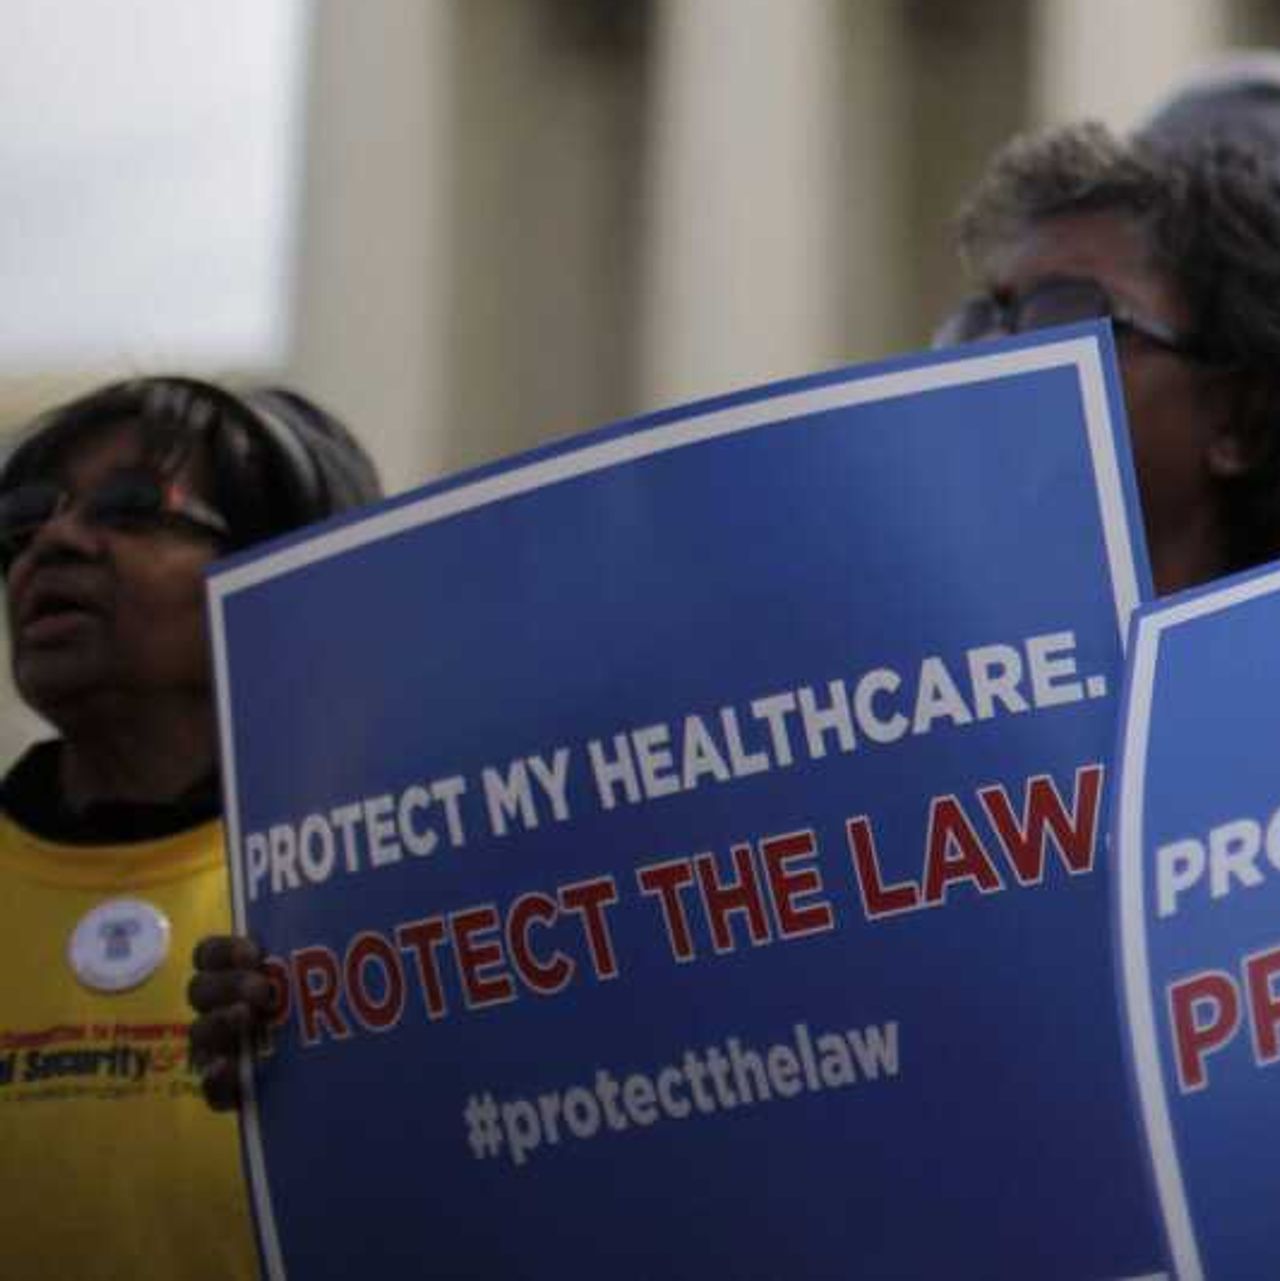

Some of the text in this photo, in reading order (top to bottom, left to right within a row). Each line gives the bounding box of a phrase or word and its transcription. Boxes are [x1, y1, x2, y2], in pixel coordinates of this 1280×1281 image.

[246, 631, 1108, 902] PROTECT MY HEALTHCARE.
[638, 828, 836, 964] THE
[462, 1019, 900, 1163] #protectthelaw
